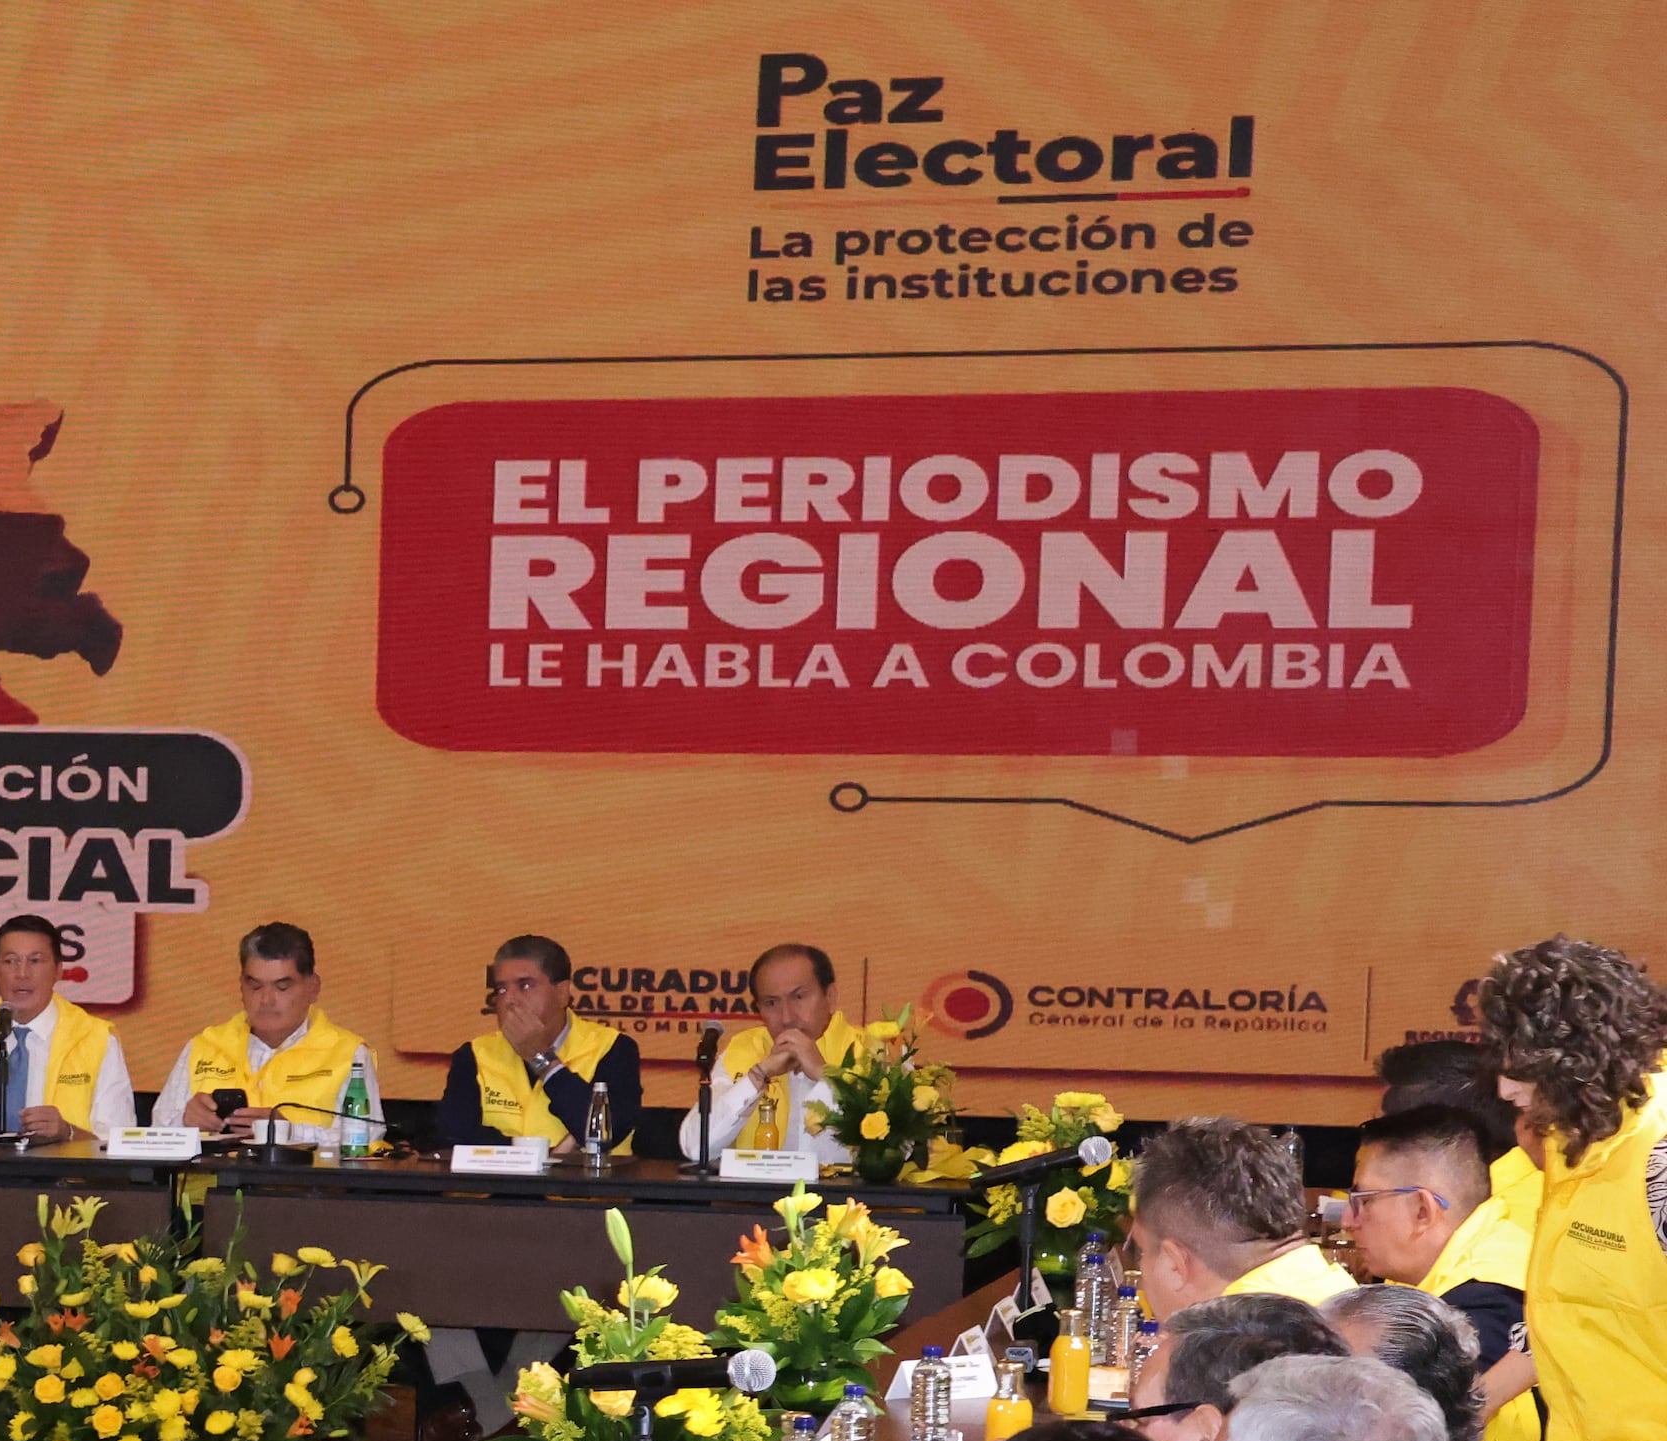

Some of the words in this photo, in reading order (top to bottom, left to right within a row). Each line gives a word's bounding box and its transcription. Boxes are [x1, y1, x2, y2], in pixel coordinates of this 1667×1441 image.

[756, 53, 944, 127] Paz
[754, 115, 1254, 191] Electoral
[750, 226, 812, 258] La
[835, 216, 1156, 264] protección
[1178, 213, 1254, 248] de
[747, 269, 827, 302] las
[846, 260, 1238, 300] instituciones
[492, 459, 610, 524] EL
[637, 450, 1424, 524] PERIODISMO
[488, 529, 1414, 630] REGIONAL
[489, 643, 564, 689] LE
[588, 643, 849, 689] HABLA
[871, 642, 931, 688] A
[952, 641, 1411, 689] COLOMBIA
[621, 995, 655, 1011] DE
[664, 996, 700, 1012] LA
[1027, 984, 1328, 1014] CONTRALORÍA
[1028, 1012, 1125, 1028] General
[1133, 1014, 1164, 1028] de
[1172, 1014, 1195, 1029] la
